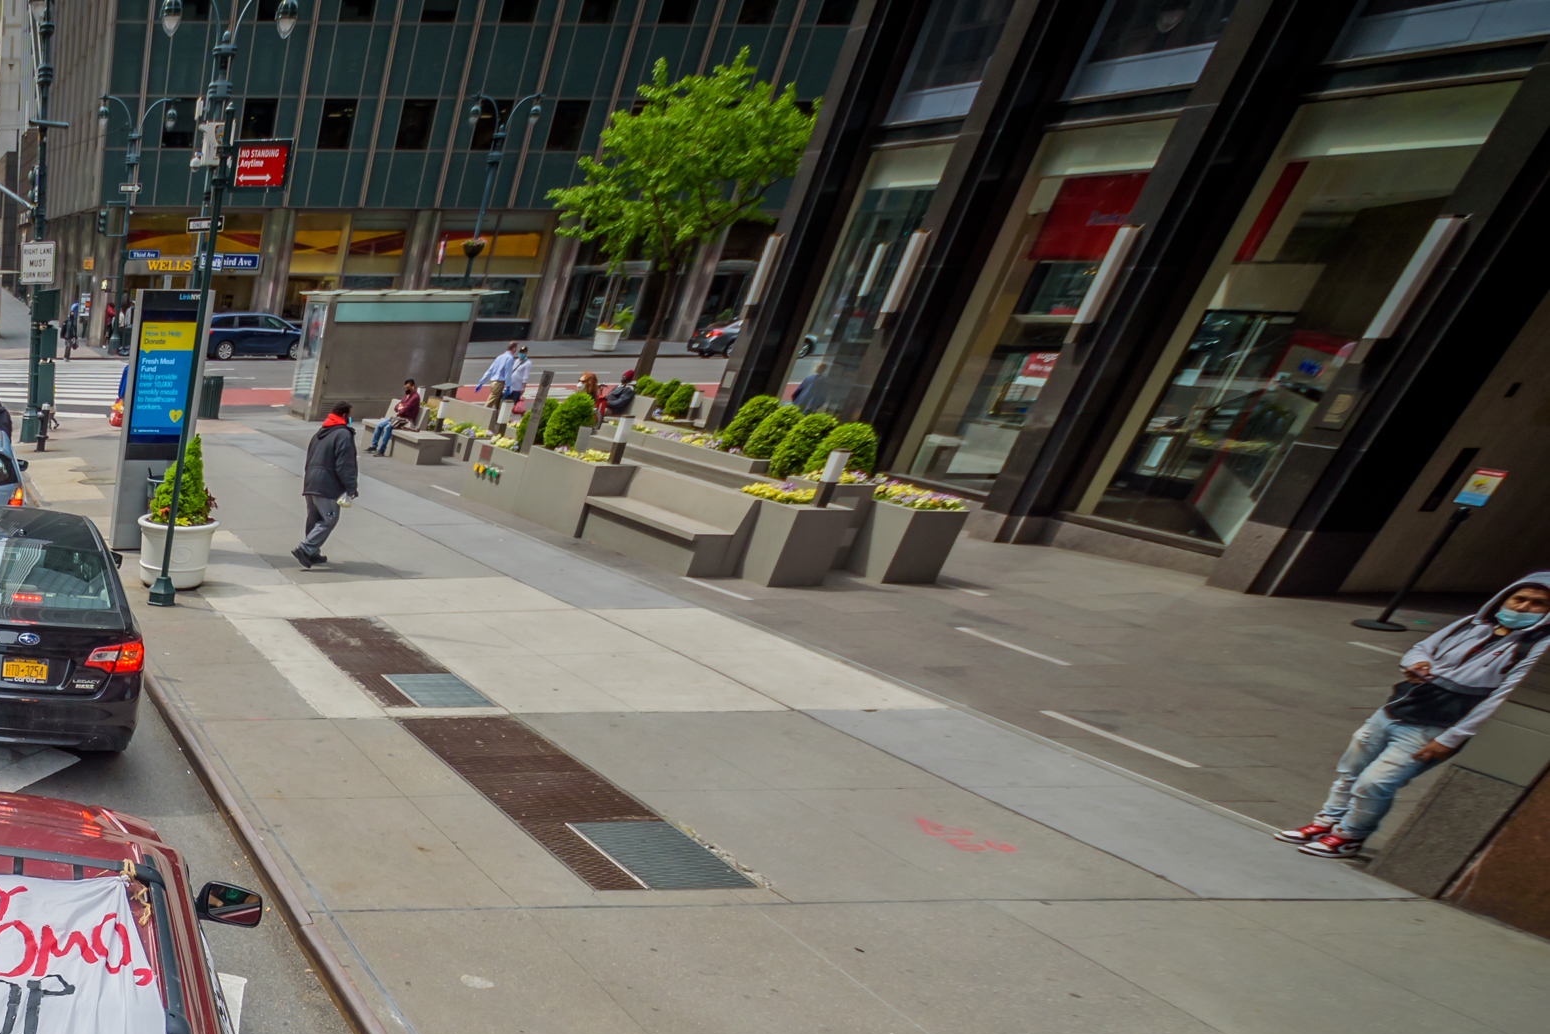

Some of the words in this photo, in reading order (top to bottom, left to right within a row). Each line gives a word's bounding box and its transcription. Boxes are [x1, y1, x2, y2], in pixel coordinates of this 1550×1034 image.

[241, 149, 250, 158] NO
[251, 148, 280, 158] STANDING
[240, 159, 264, 169] Anytime
[40, 247, 53, 255] LANE
[29, 259, 46, 267] MUST
[147, 260, 192, 271] WELLS
[237, 257, 253, 266] Ave
[23, 271, 36, 279] TURN
[168, 330, 182, 338] Help
[141, 357, 159, 365] Fresh
[160, 357, 175, 365] Meal
[140, 365, 157, 373] Fund
[140, 373, 154, 381] Help
[154, 373, 178, 381] provide
[154, 380, 174, 388] 10,000
